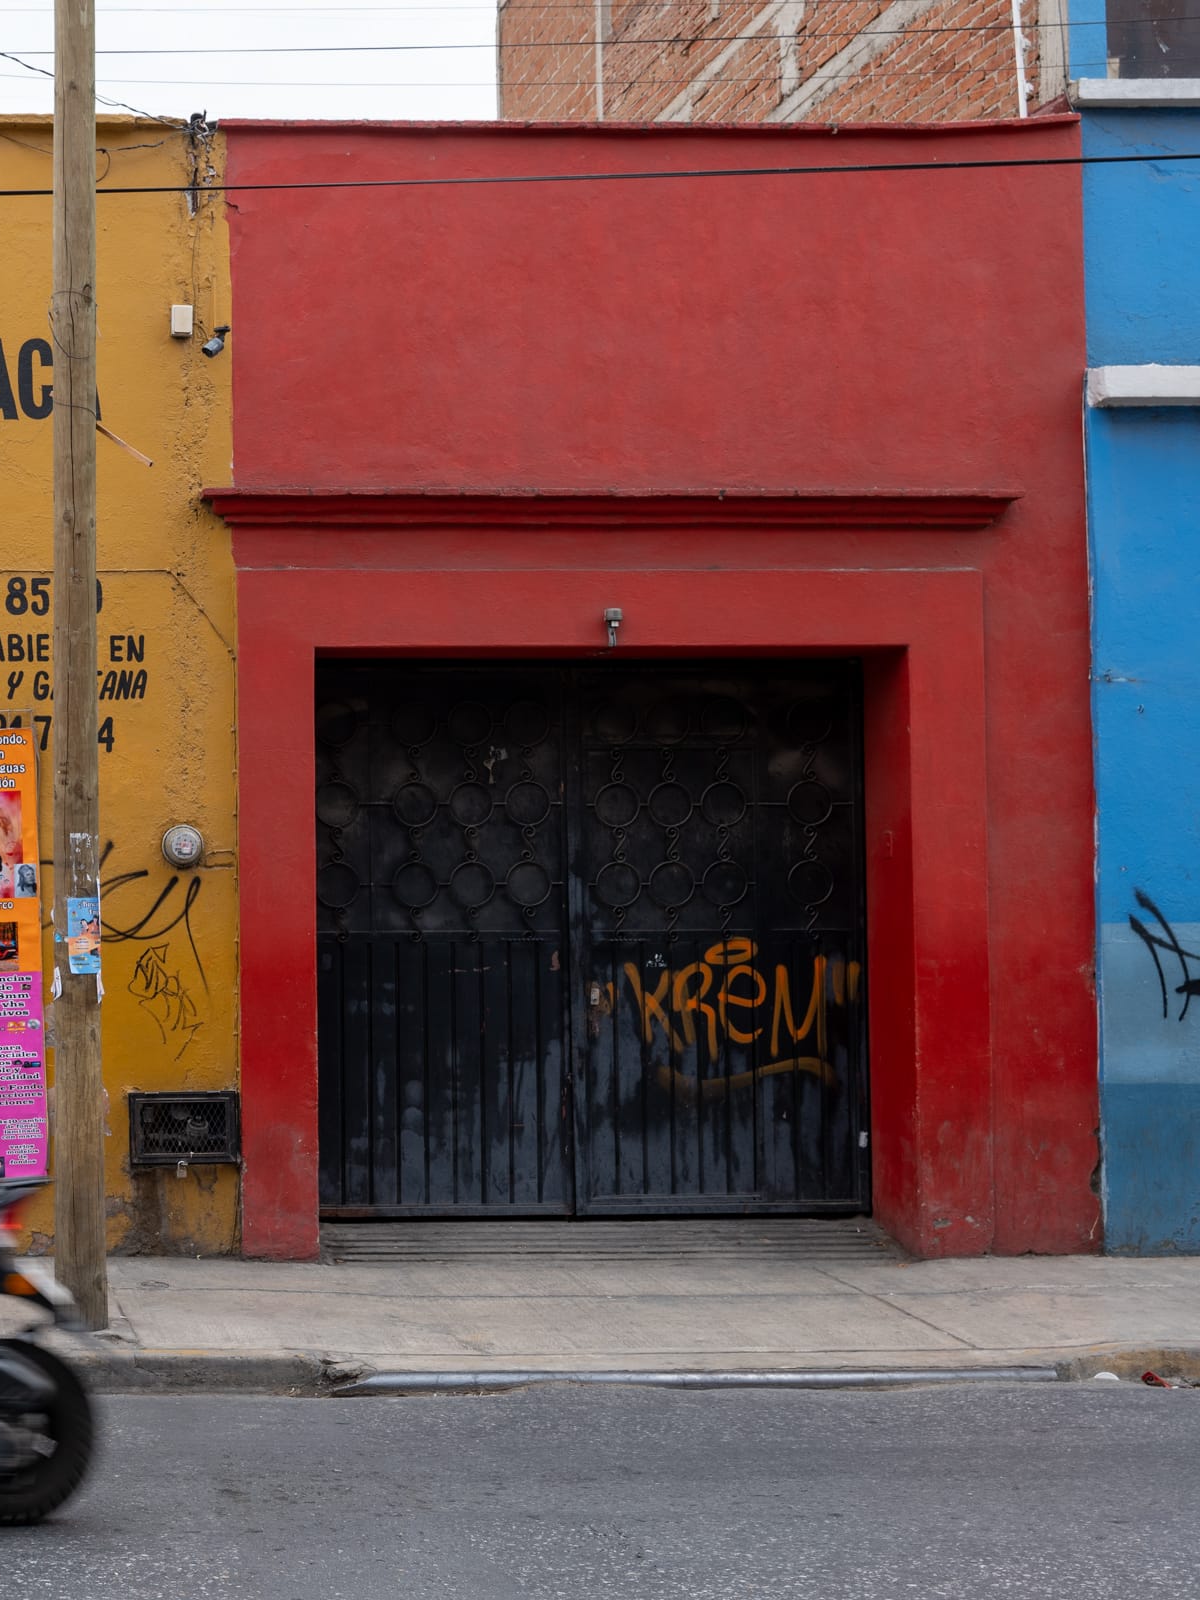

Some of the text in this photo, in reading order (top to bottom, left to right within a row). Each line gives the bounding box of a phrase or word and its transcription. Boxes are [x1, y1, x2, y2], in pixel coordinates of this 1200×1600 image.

[5, 577, 51, 617] 85
[110, 635, 145, 662] EN
[7, 671, 24, 699] Y
